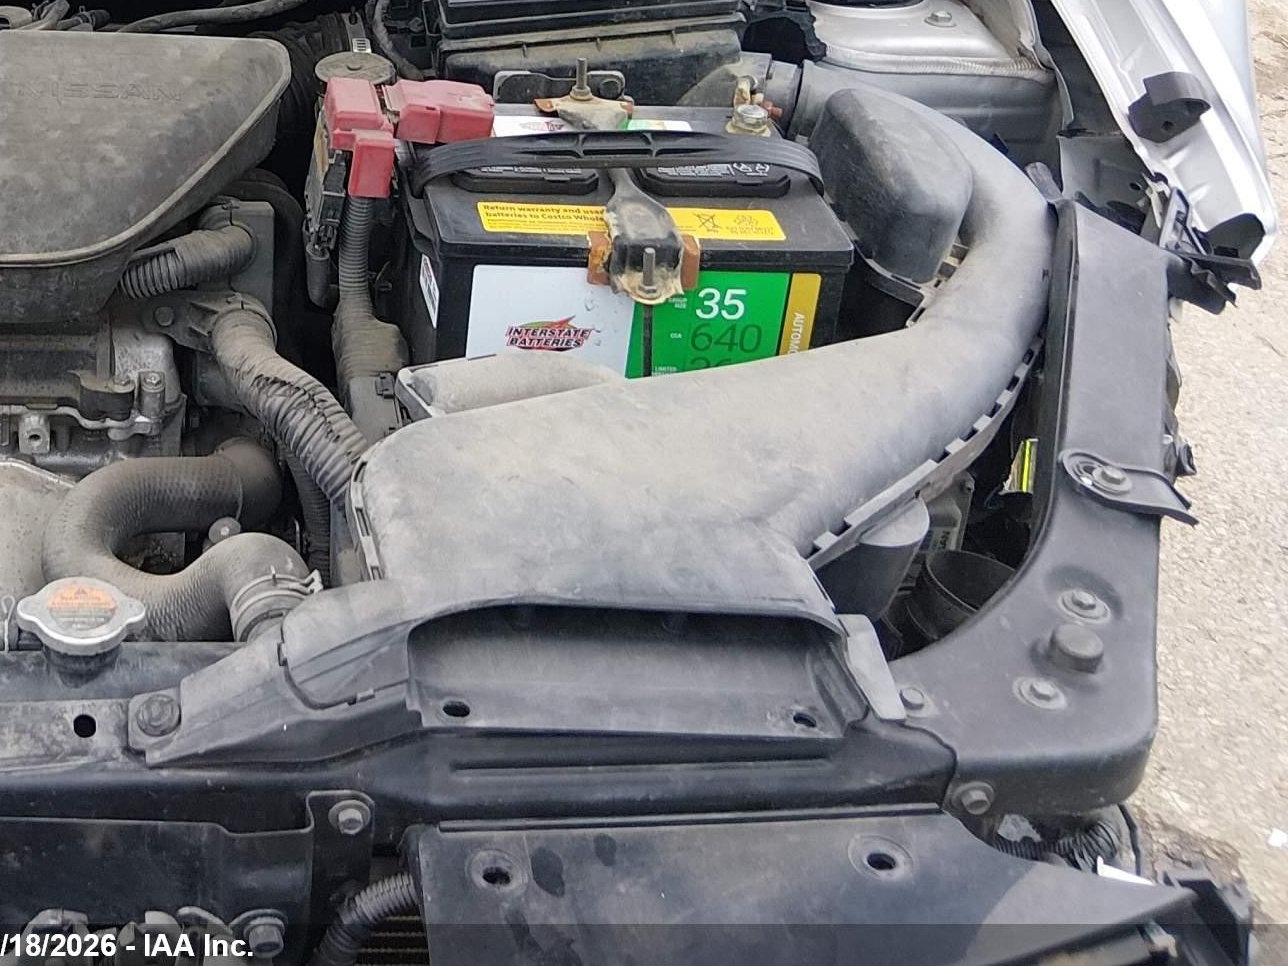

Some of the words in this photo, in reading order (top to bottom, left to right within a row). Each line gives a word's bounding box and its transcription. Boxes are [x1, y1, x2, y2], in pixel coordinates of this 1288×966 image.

[15, 82, 184, 101] NISSAN
[573, 214, 605, 222] Whole
[695, 287, 747, 320] 35
[507, 326, 592, 338] INTERSTATE
[690, 322, 763, 353] 640
[787, 312, 805, 354] AUTOMO
[508, 337, 582, 347] BATTERIES
